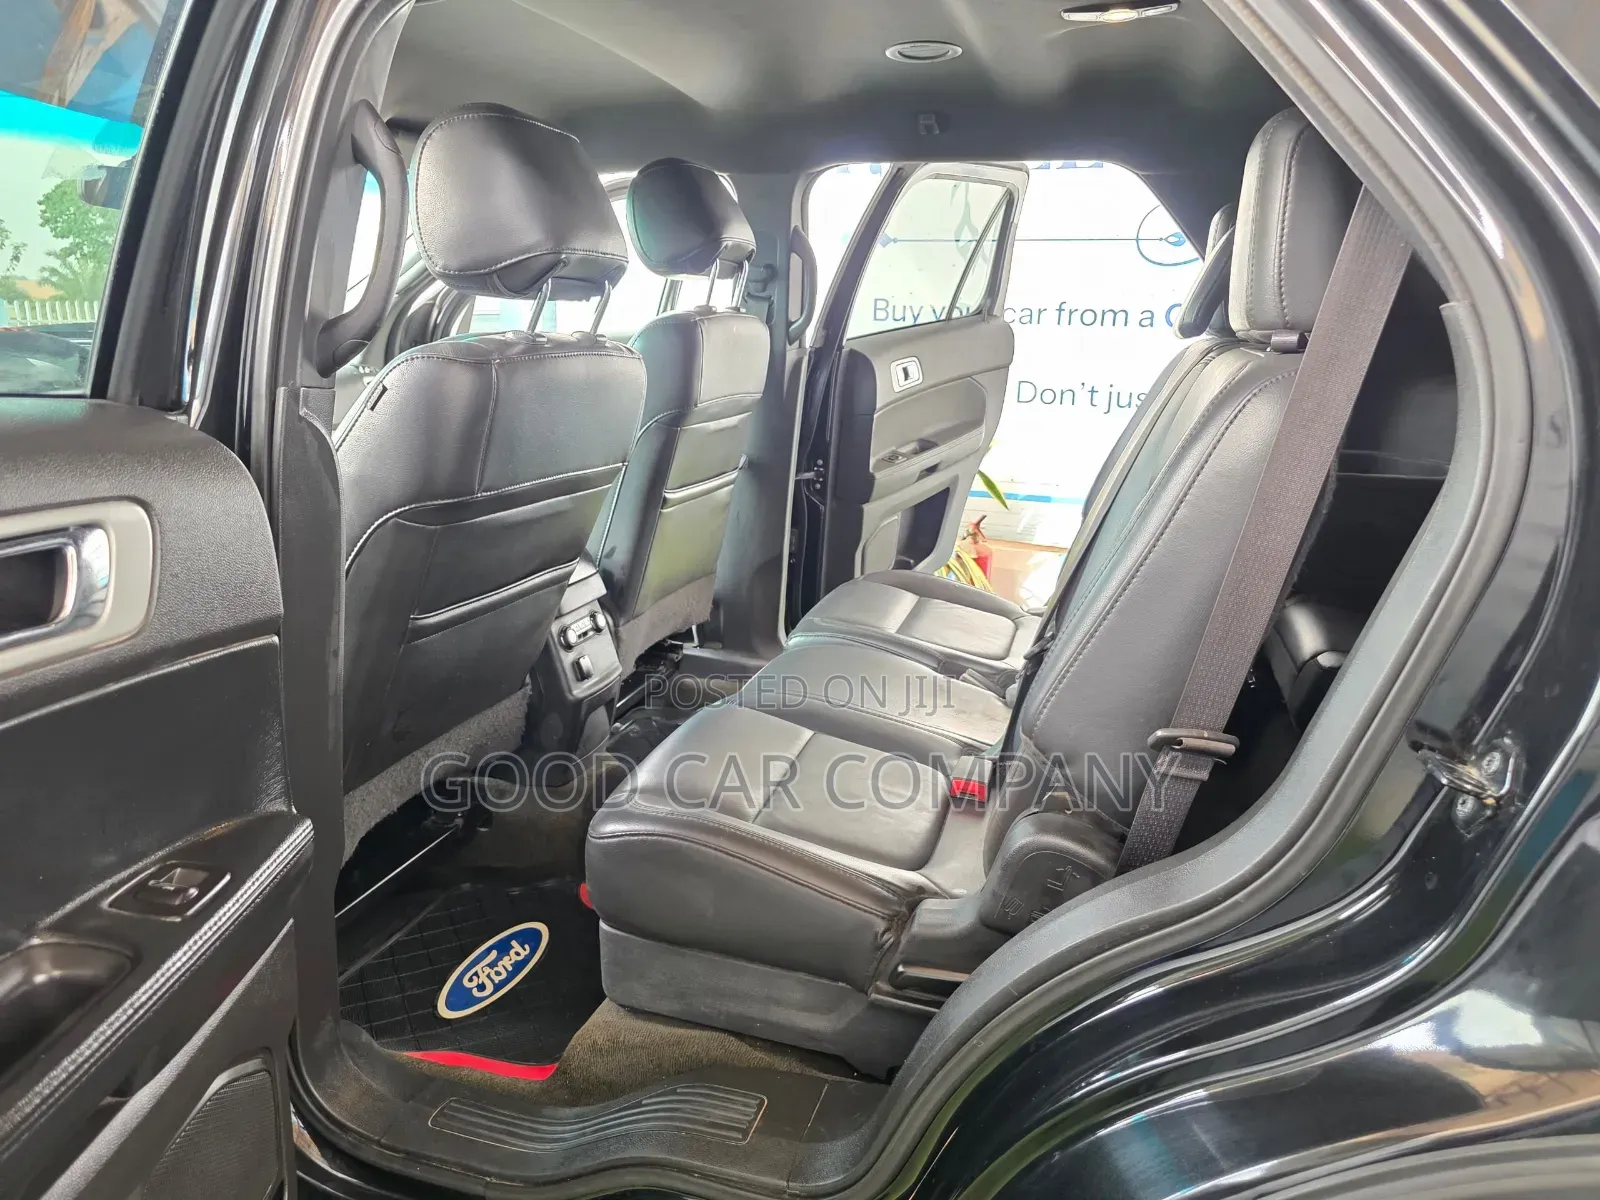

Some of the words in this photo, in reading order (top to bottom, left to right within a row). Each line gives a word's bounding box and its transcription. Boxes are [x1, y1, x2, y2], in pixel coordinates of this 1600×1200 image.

[873, 298, 923, 325] Buy
[1004, 307, 1047, 325] car
[1056, 301, 1129, 327] from
[1138, 309, 1154, 328] a
[1017, 380, 1098, 407] Don't
[1104, 384, 1149, 414] jus
[463, 940, 530, 997] Ford
